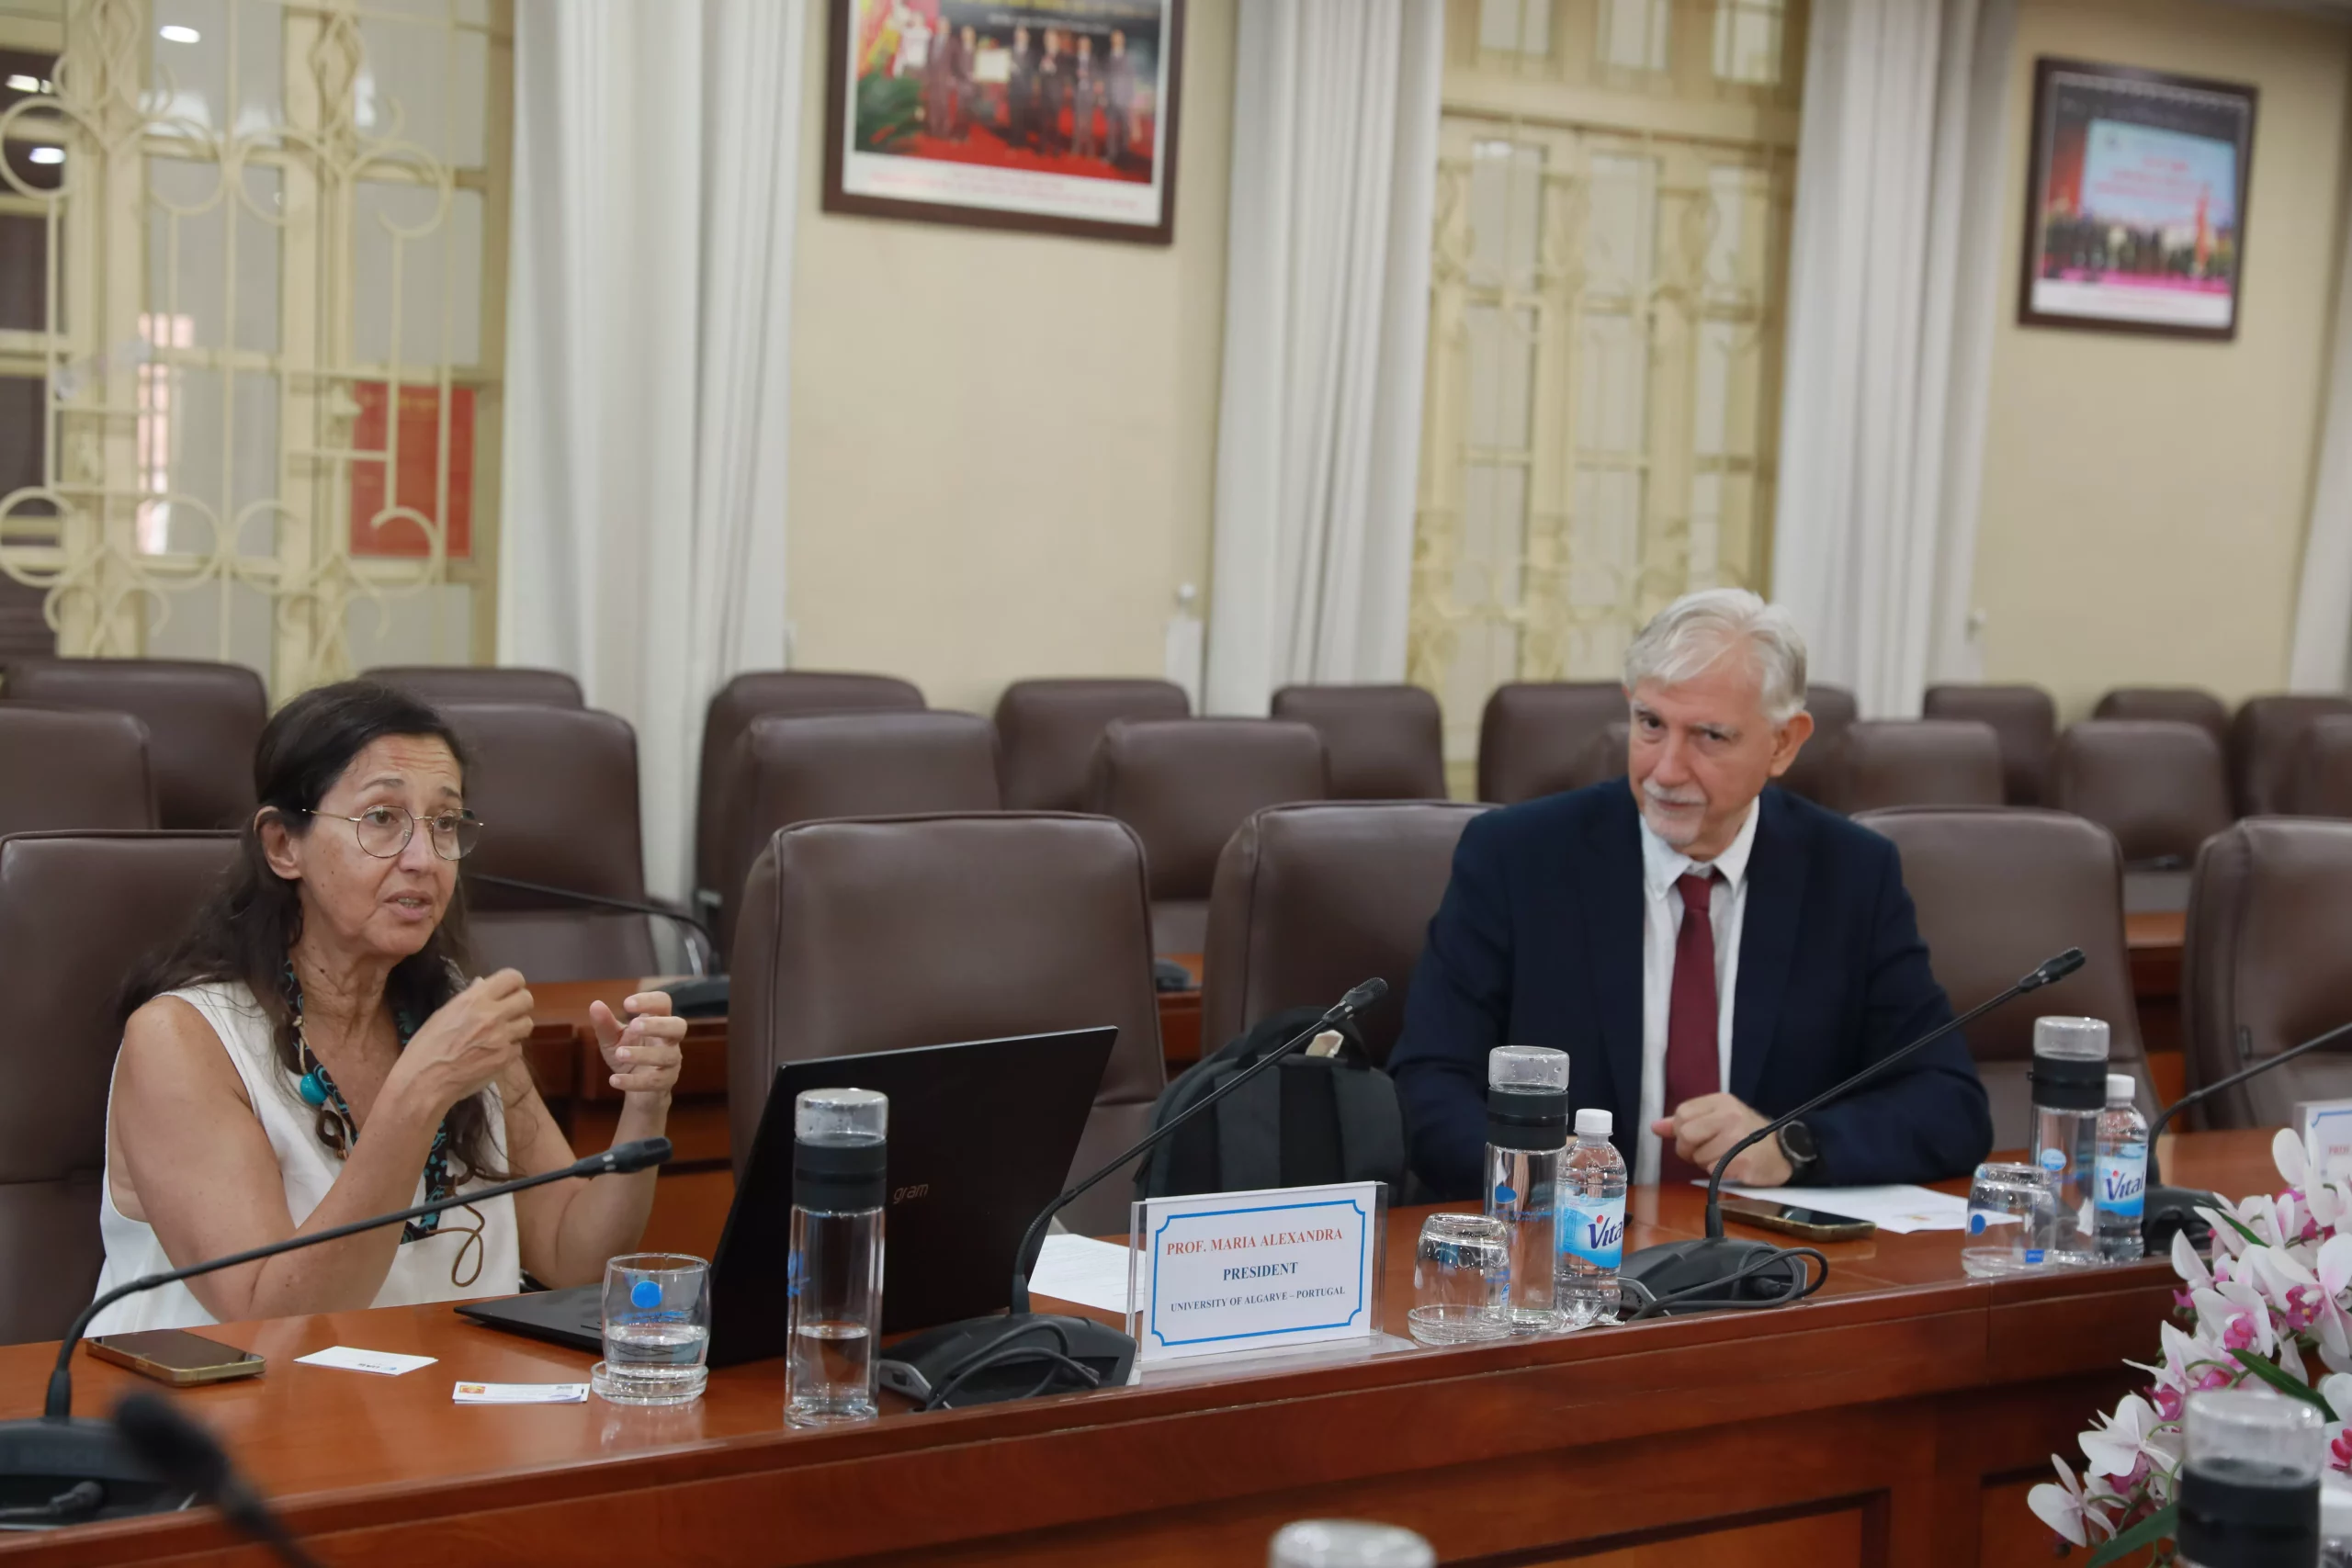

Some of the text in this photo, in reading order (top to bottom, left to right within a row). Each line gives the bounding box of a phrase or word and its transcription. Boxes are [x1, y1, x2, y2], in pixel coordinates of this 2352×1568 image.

[893, 1184, 928, 1204] gram
[2106, 1170, 2144, 1201] Vital
[1166, 1228, 1343, 1256] PROF. MARIA ALEXANDRA
[1587, 1215, 1623, 1249] Vita
[1223, 1262, 1298, 1280] PRESIDENT
[1170, 1298, 1227, 1312] UNIVERSITY
[1229, 1296, 1242, 1306] OF
[1244, 1292, 1288, 1304] ALGARVE
[1296, 1286, 1345, 1299] PORTUGAL
